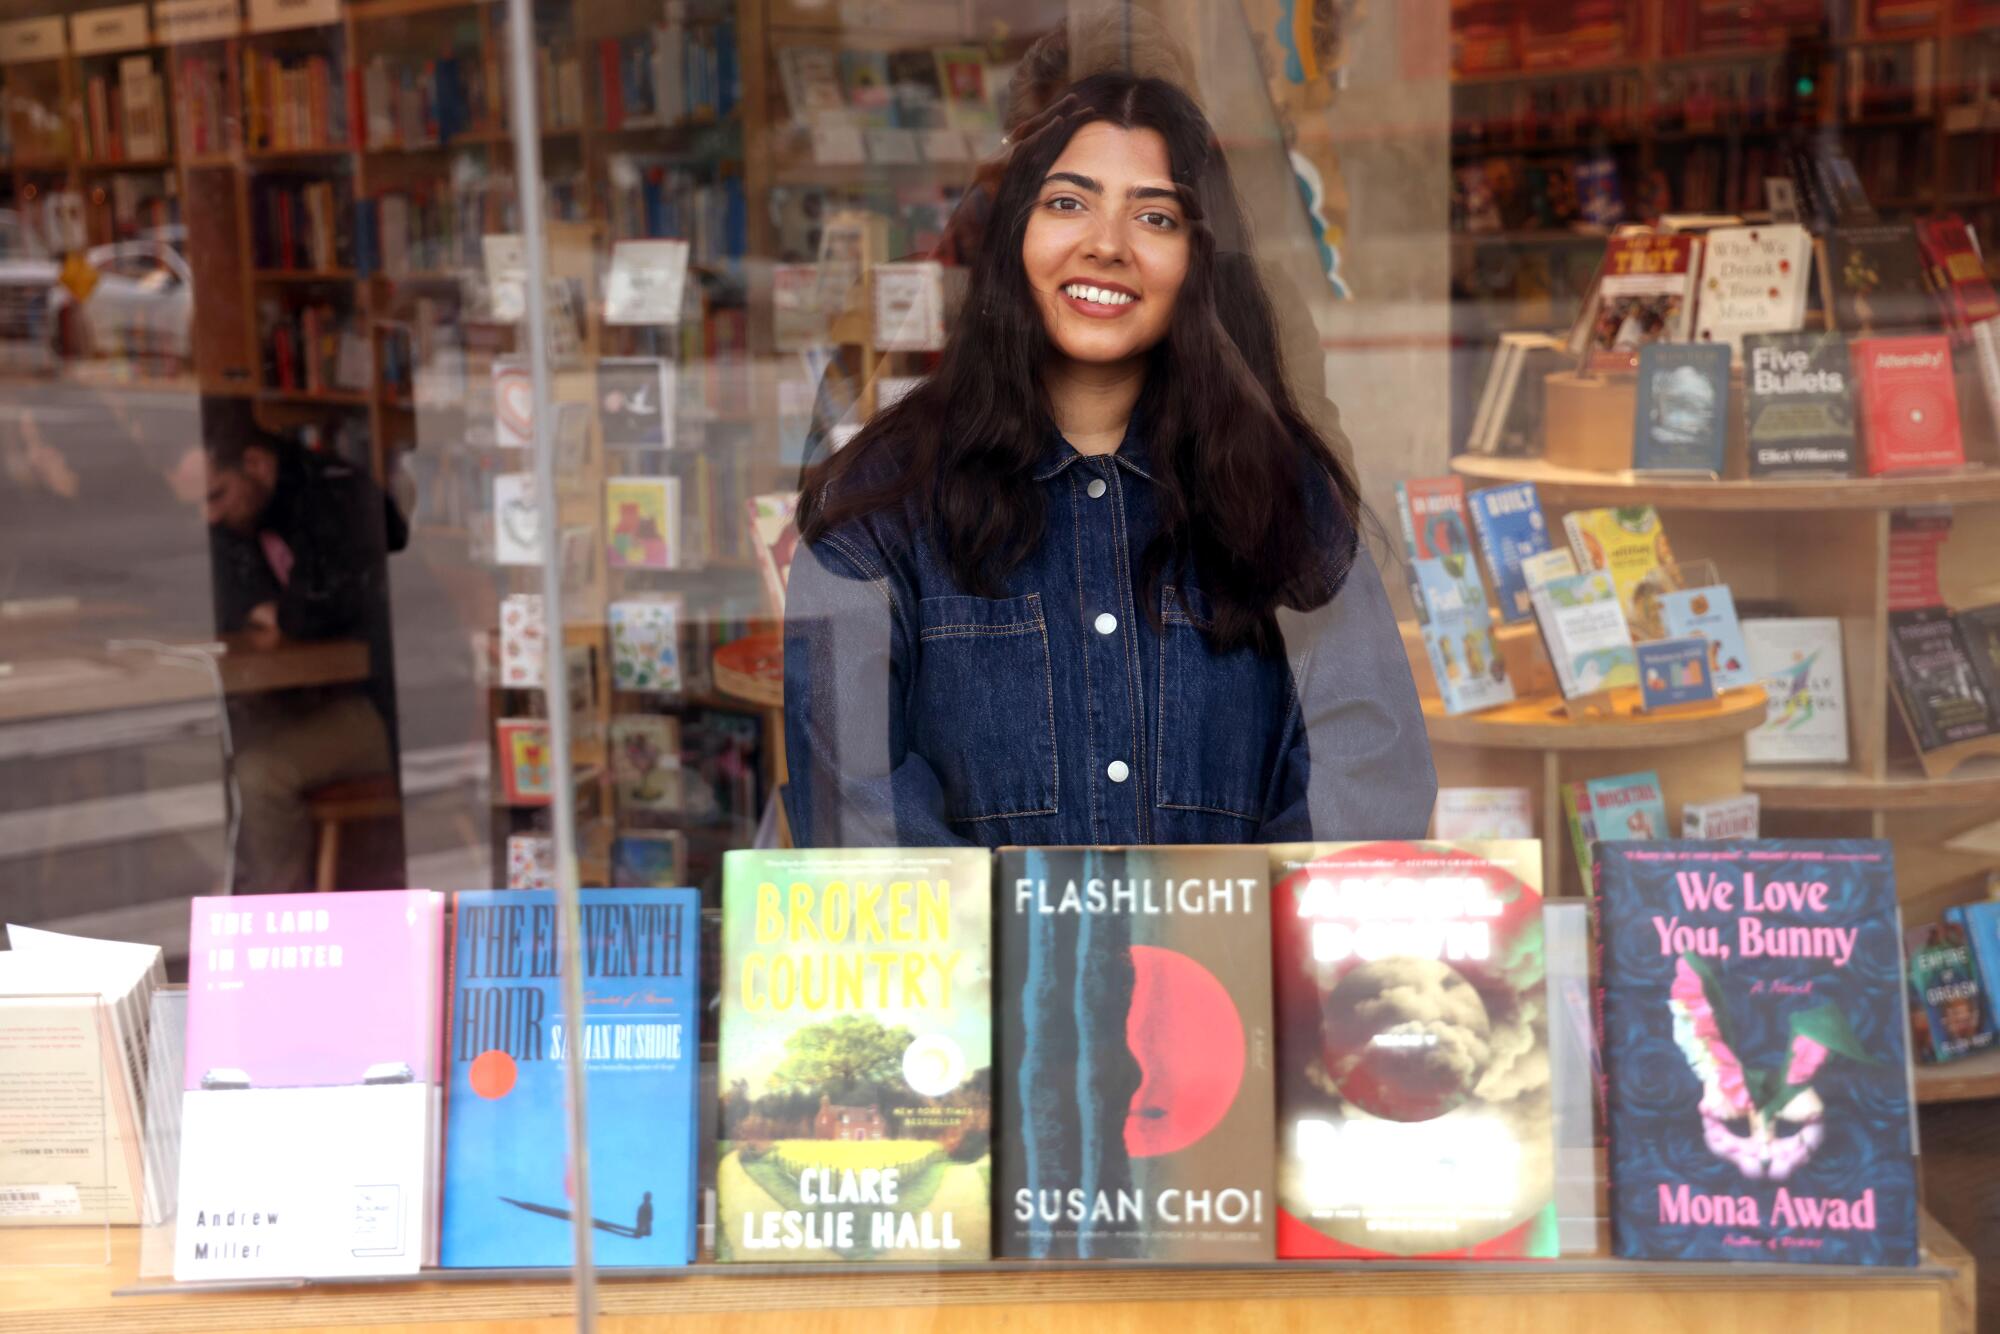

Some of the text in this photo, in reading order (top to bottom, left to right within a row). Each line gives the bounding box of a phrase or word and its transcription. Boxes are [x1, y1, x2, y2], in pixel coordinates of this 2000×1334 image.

[1753, 347, 1810, 371] Five
[1754, 369, 1844, 395] Bullets
[1794, 447, 1849, 462] Williams
[1015, 878, 1257, 914] FLASHLIGHT
[1676, 871, 1829, 912] We Love
[210, 908, 330, 936] THE LAND
[755, 878, 951, 945] BROKEN
[207, 944, 344, 973] IN WINTER
[465, 902, 684, 979] THE ELVENTH
[1652, 916, 1859, 967] You, Bunny
[741, 948, 962, 1013] COUNTRY
[459, 985, 546, 1062] HOUR
[549, 1023, 683, 1060] SAMAN RUSHDIE
[800, 1168, 900, 1205] CLARE
[196, 1209, 280, 1228] Andrew
[1014, 1187, 1264, 1224] SUSAN CHOI
[1658, 1183, 1877, 1231] Mona Awad
[743, 1210, 962, 1250] LESLIE HALL
[195, 1242, 262, 1260] Miller
